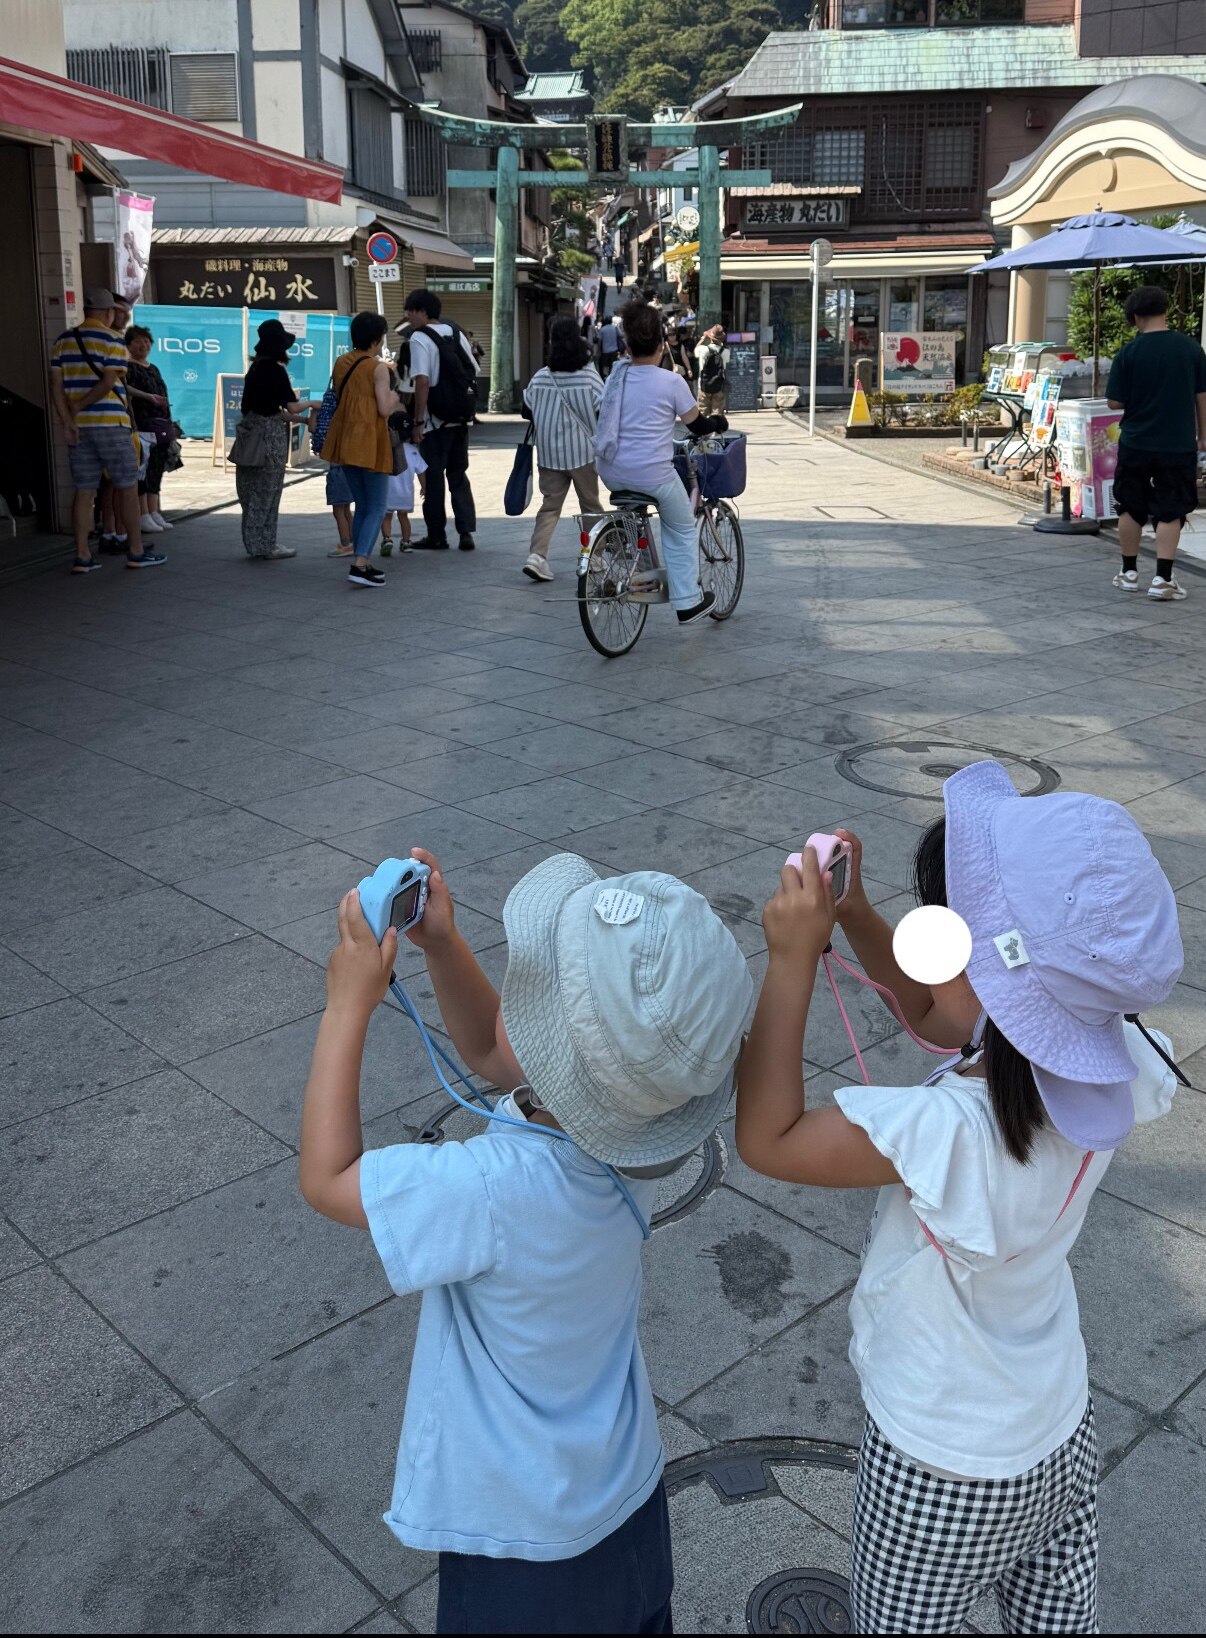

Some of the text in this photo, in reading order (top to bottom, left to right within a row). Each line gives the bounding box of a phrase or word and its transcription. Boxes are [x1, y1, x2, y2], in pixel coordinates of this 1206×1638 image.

[748, 201, 841, 223] 海産物 丸だい
[205, 259, 289, 272] 磯料理・海産物
[372, 268, 397, 278] ここまで
[179, 272, 320, 304] 丸だい 仙水
[157, 337, 221, 354] IQOS
